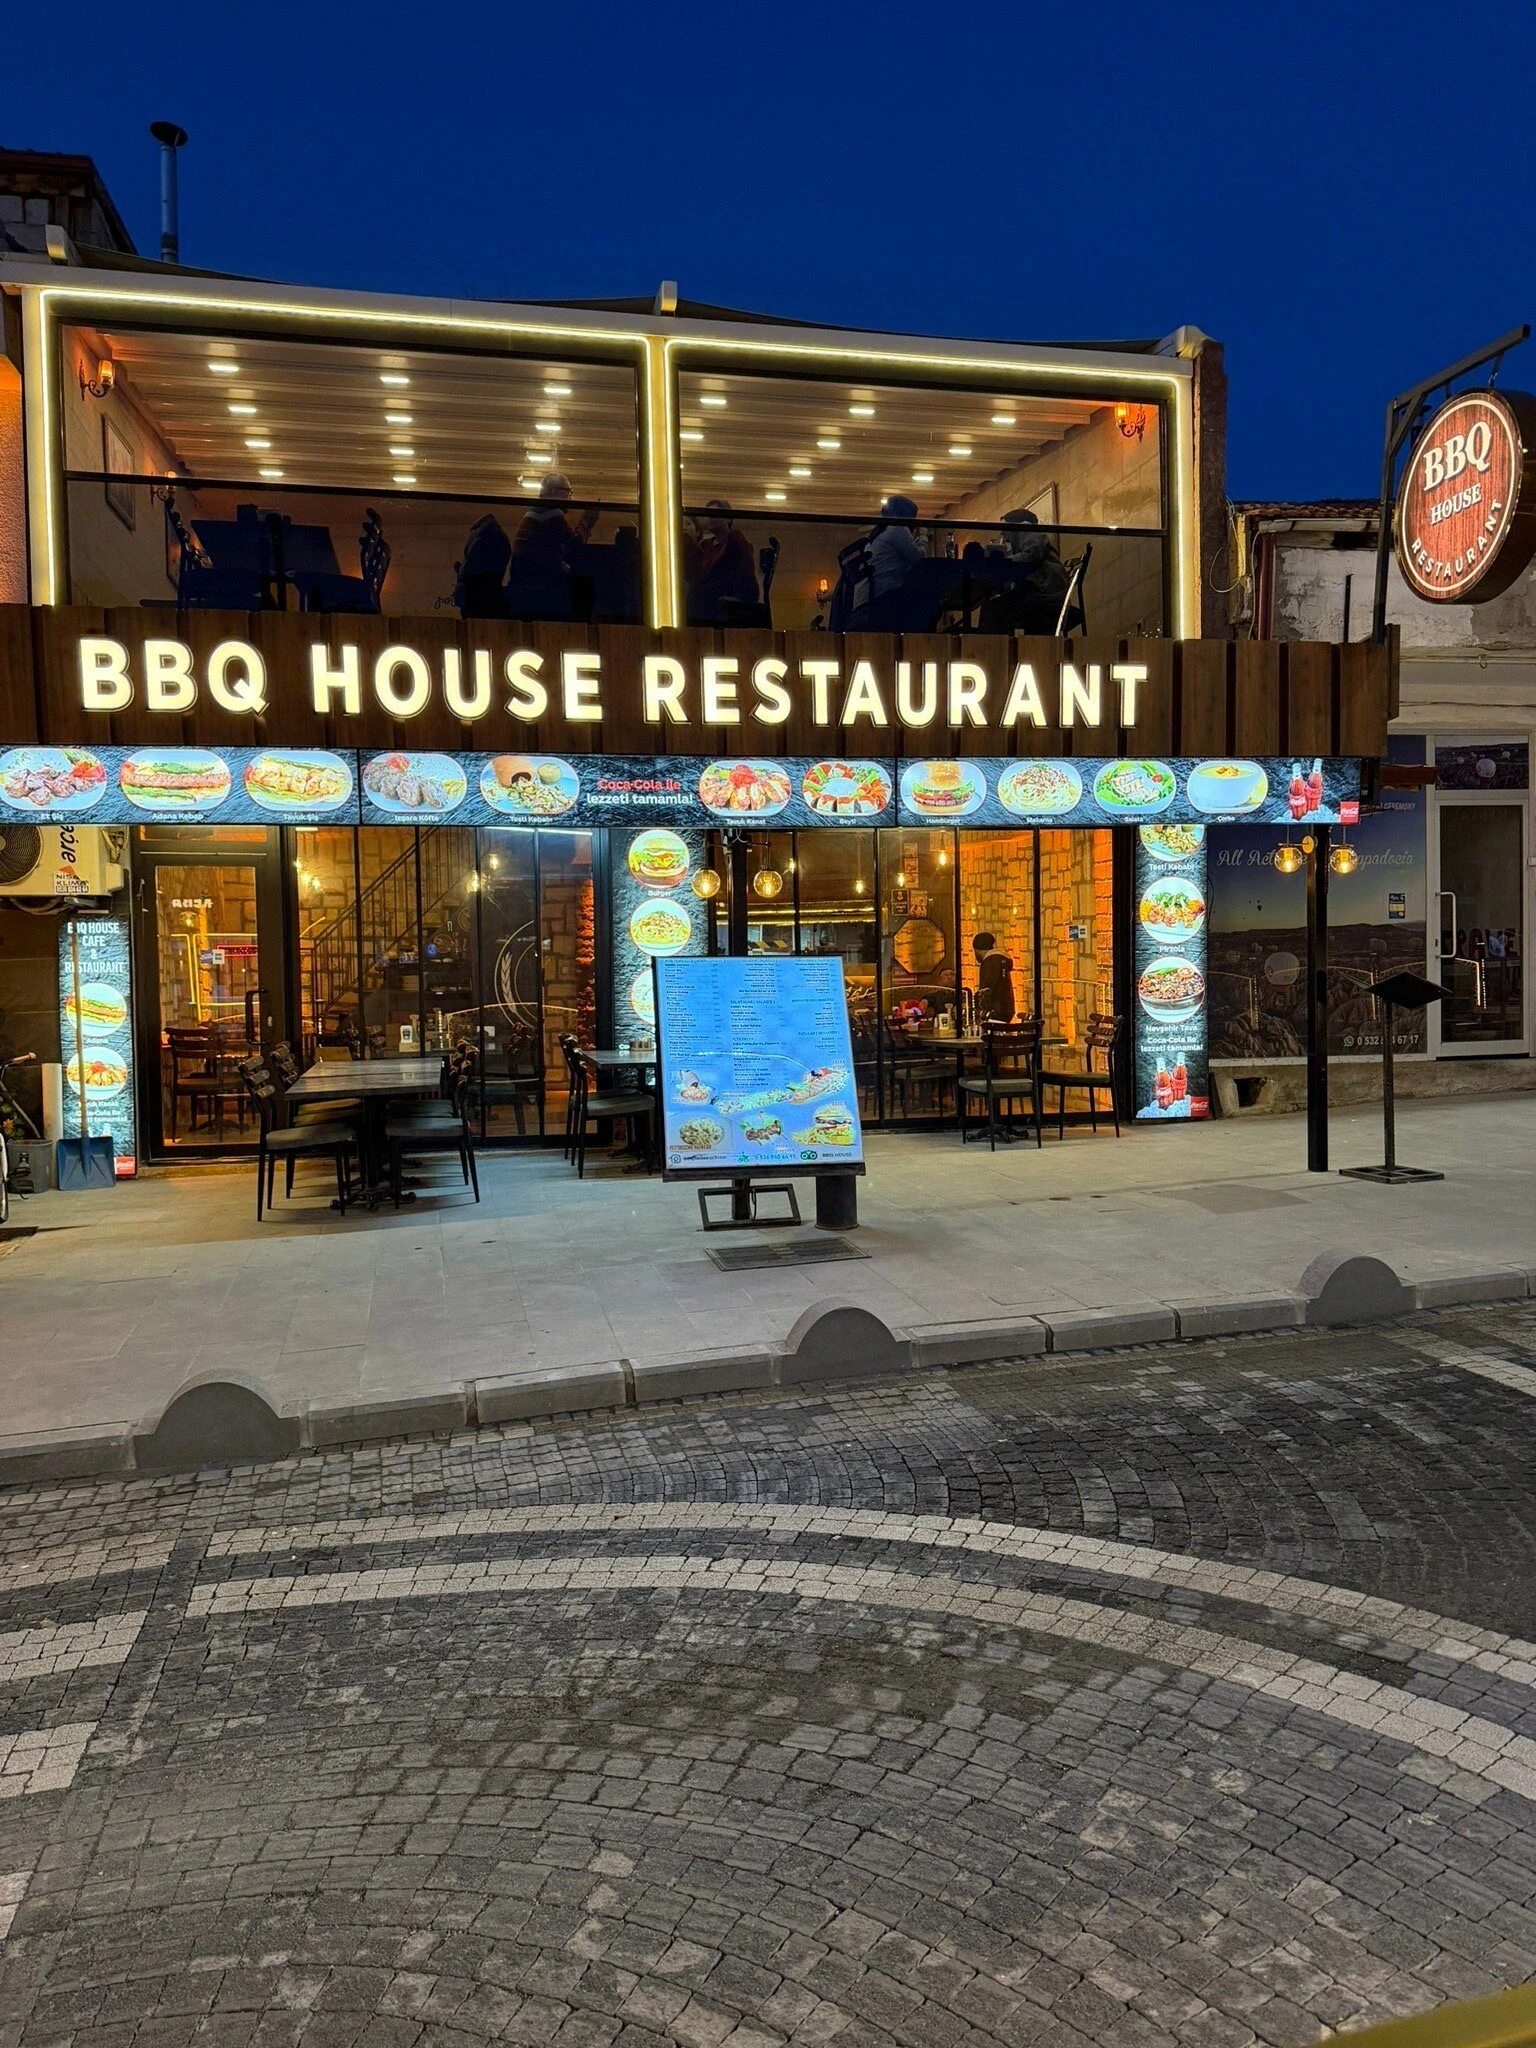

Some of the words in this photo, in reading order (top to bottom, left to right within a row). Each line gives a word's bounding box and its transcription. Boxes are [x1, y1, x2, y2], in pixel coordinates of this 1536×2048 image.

[1424, 421, 1492, 491] BBQ
[1430, 483, 1482, 525] HOUSE
[1411, 499, 1502, 578] RESTAURANT
[80, 637, 269, 717] BBQ
[311, 643, 603, 722] HOUSE
[642, 655, 1147, 728] RESTAURANT
[597, 779, 662, 791] Coca-Cola
[586, 793, 629, 804] lezzeti
[632, 794, 693, 804] tamamla!
[152, 812, 178, 820] Adana
[283, 813, 306, 822] Tavuk
[1217, 848, 1243, 866] All
[1149, 863, 1167, 871] Testi
[88, 922, 120, 934] HOUSE
[82, 935, 106, 947] CAFE
[90, 948, 98, 960] &
[1159, 945, 1185, 953] Pirzola
[1145, 1024, 1178, 1033] Nevşehir
[1147, 1036, 1186, 1044] Coca-Cola
